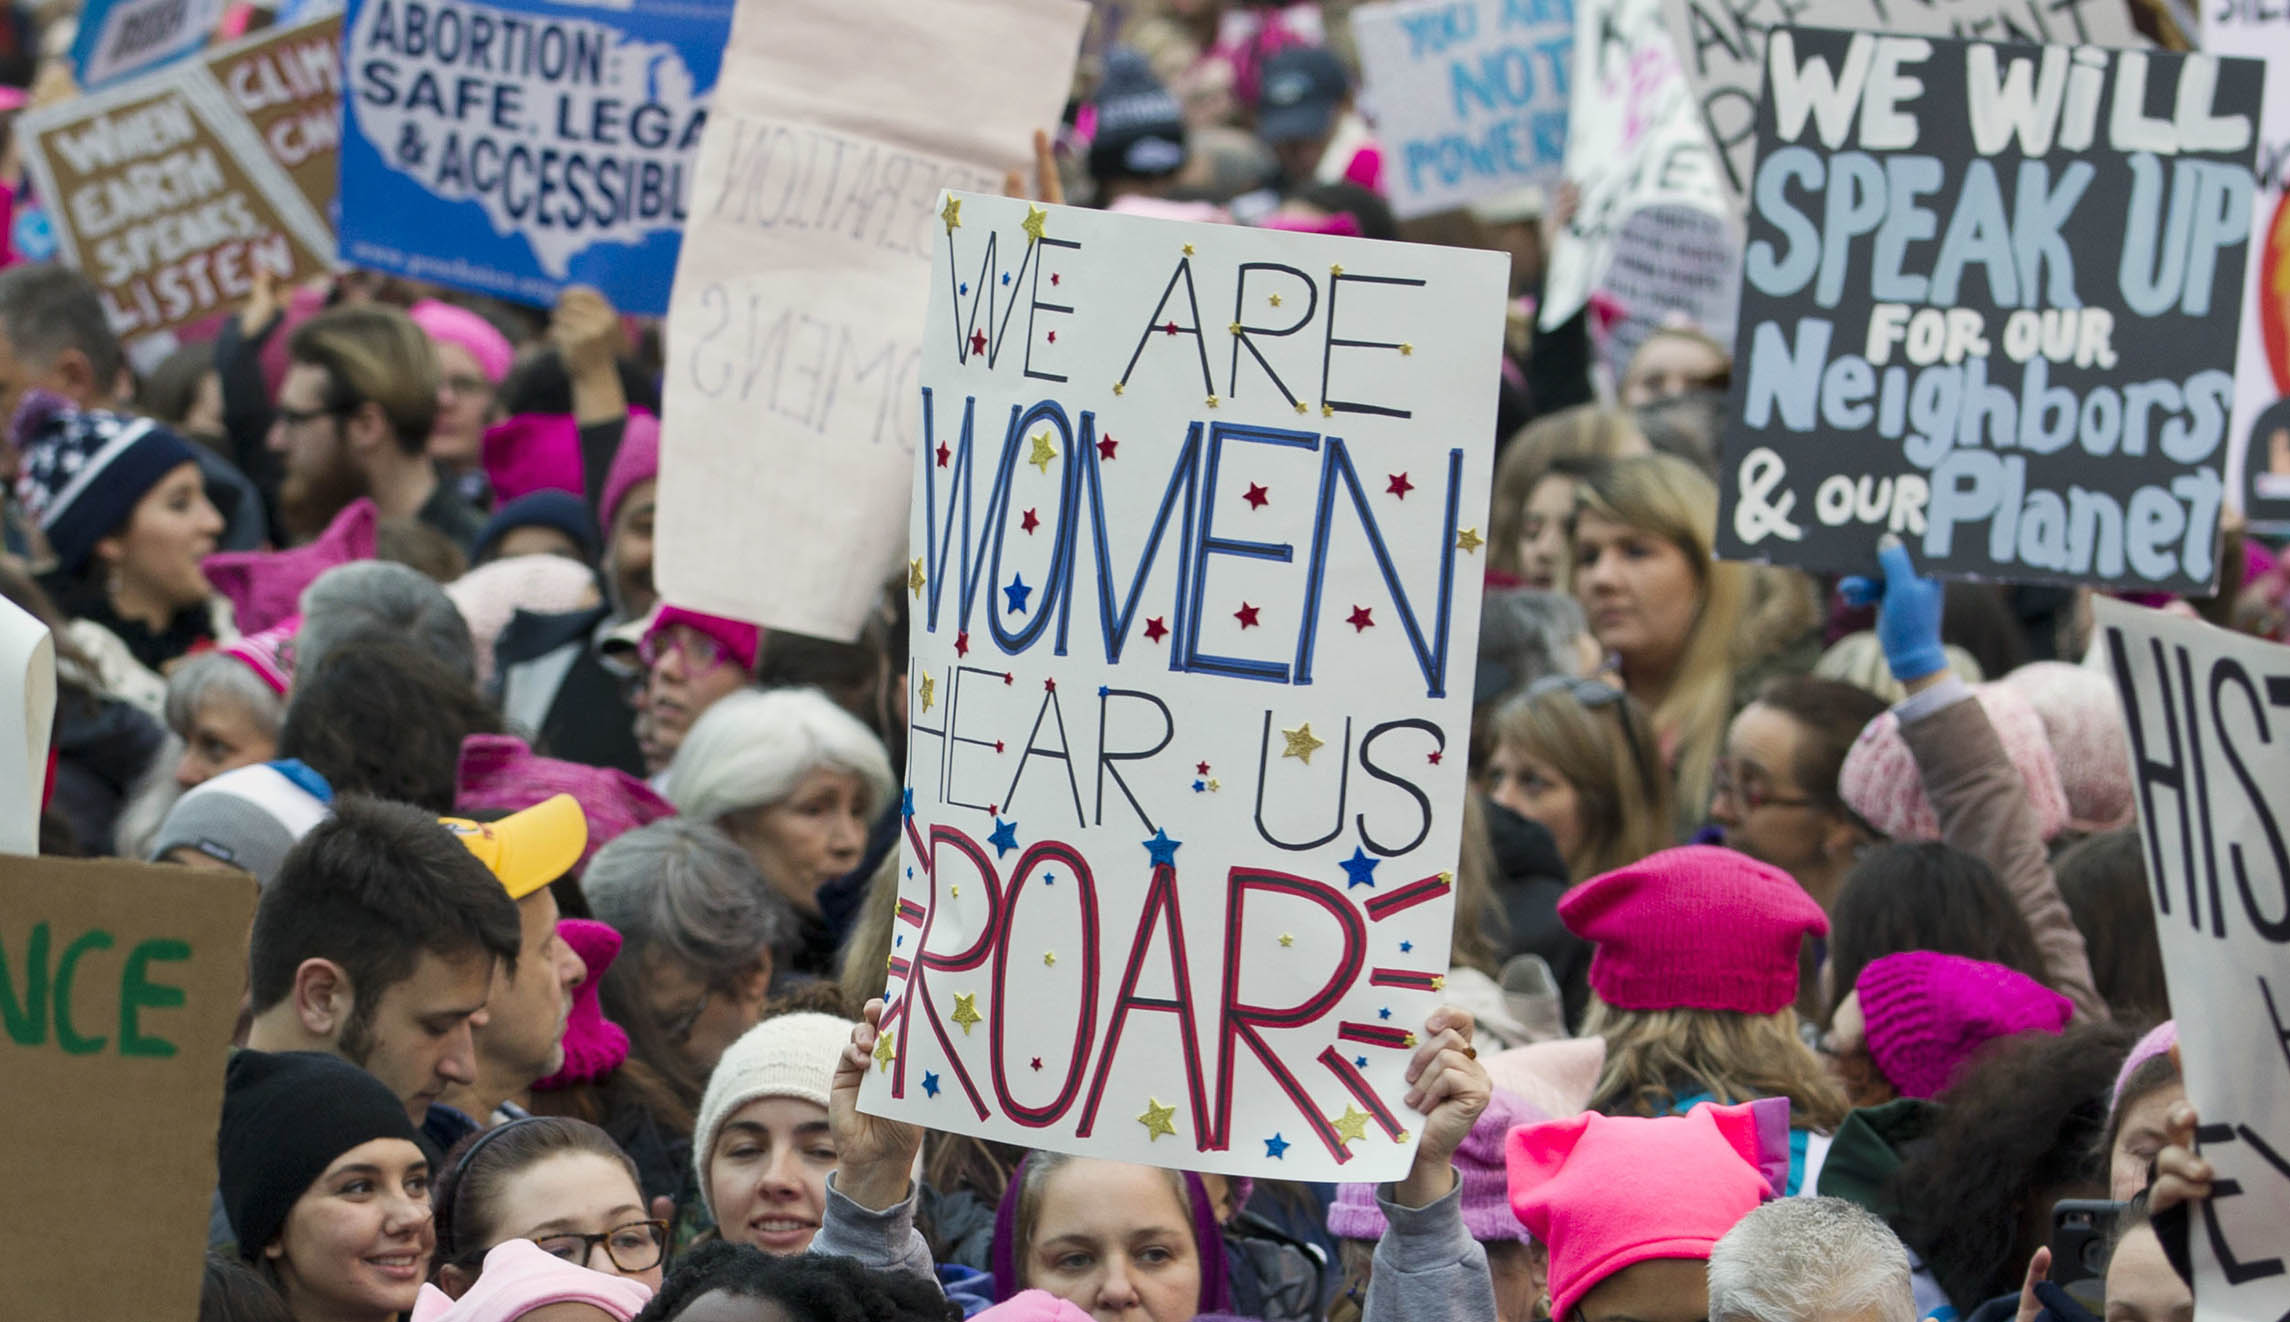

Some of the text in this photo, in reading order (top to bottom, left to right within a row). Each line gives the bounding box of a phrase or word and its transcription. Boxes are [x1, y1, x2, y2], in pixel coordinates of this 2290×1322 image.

[367, 0, 624, 87] ABORTION:
[1450, 35, 1573, 117] NOT
[1769, 32, 1932, 150] WE
[398, 121, 426, 164] &
[101, 233, 296, 337] LISTEN
[1746, 147, 2094, 309] SPEAK
[2118, 152, 2254, 316] UP
[946, 224, 1082, 383] WE
[1114, 256, 1427, 418] ARE
[1865, 303, 2118, 369] FOR OUR
[1744, 318, 2235, 469] Neighbors
[922, 386, 1464, 698] WOMEN
[1733, 447, 2225, 582] & OUR Planet
[906, 656, 1447, 858] HEAR US
[892, 823, 1368, 1164] ROAR
